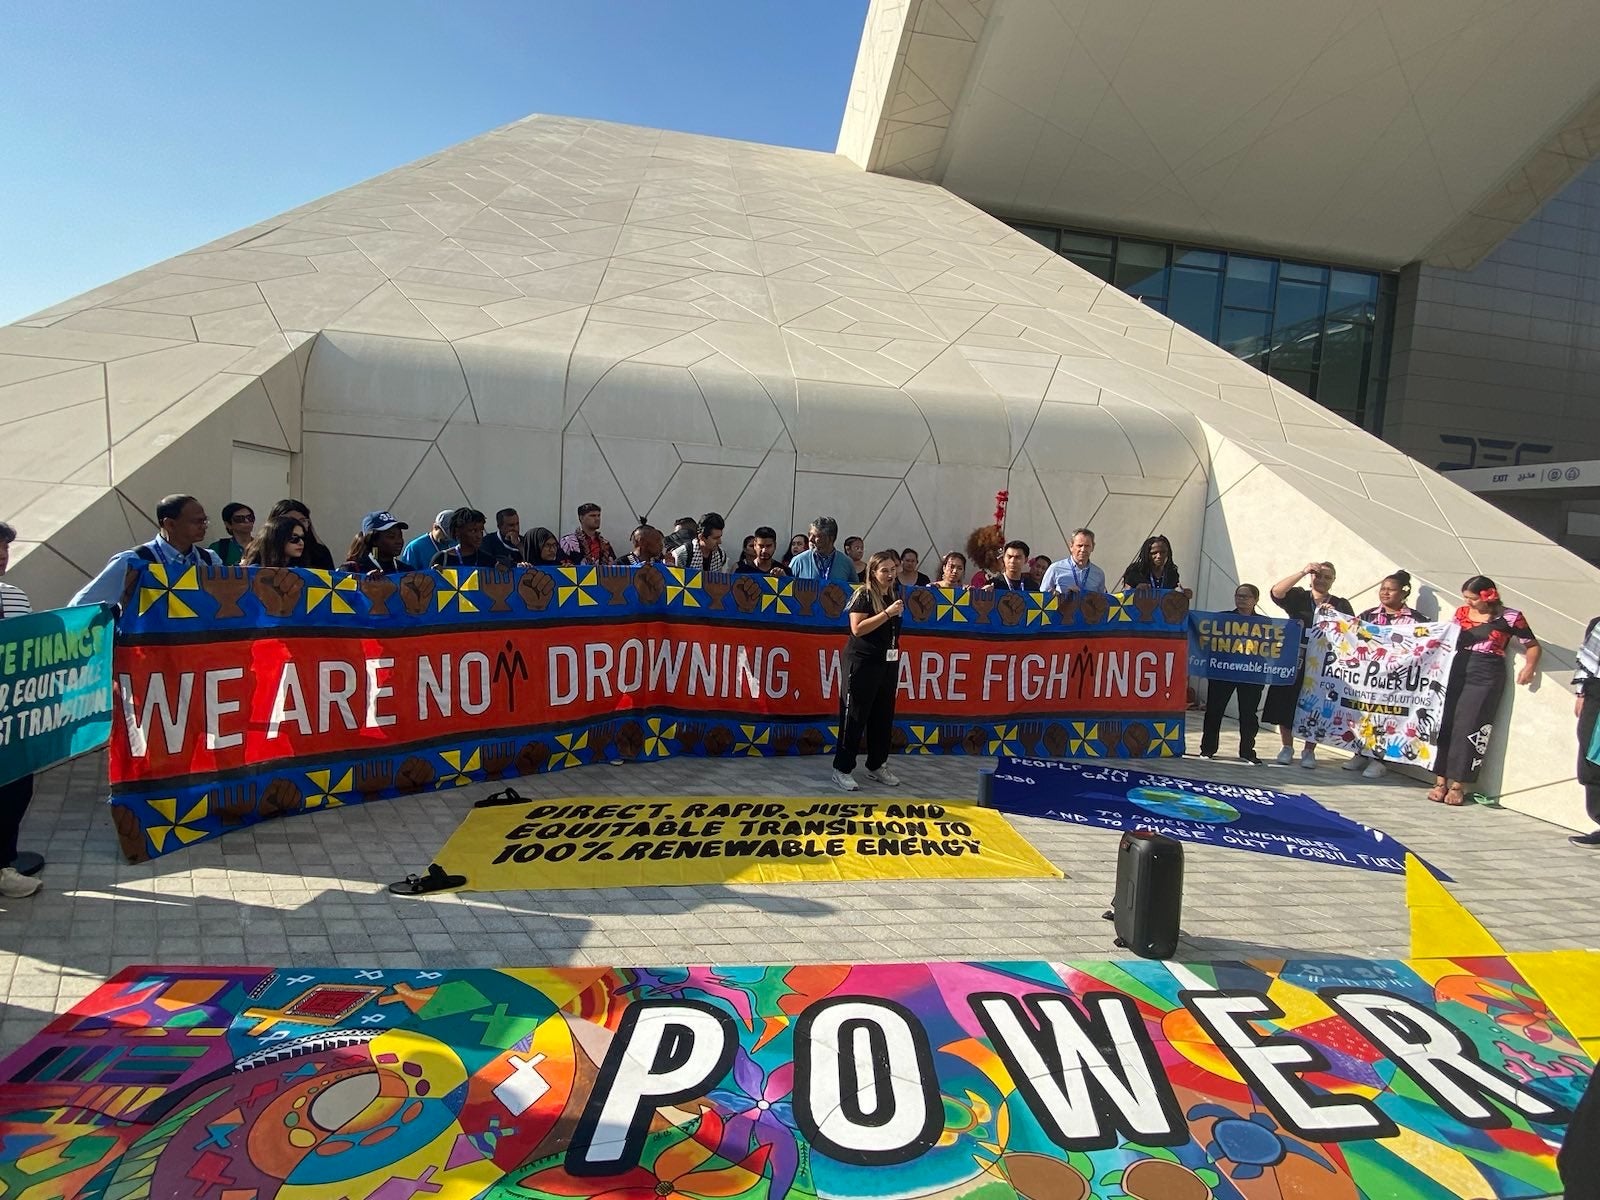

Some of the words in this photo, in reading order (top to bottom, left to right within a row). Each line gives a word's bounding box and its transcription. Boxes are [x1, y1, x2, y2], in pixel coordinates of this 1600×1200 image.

[1492, 474, 1508, 482] EXIT
[1199, 620, 1285, 640] CLIMATE
[22, 626, 104, 671] FINANCE
[1199, 636, 1284, 659] FINANCE
[1189, 655, 1207, 667] for
[1209, 657, 1262, 673] Renewable
[1263, 662, 1295, 679] Energy!
[1406, 665, 1430, 692] UP
[120, 667, 243, 757] WE
[266, 658, 397, 739] ARE
[896, 651, 970, 700] ARE
[1343, 686, 1377, 701] CLIMATE
[1382, 693, 1432, 706] SOLUTIONS
[1351, 701, 1402, 714] TUVALU
[795, 803, 879, 817] JUST
[885, 804, 946, 819] AND
[505, 820, 726, 840] EQUITABLE
[739, 819, 928, 837] TRANSITION
[933, 820, 972, 837] TO
[1045, 809, 1089, 822] AND
[1097, 817, 1123, 827] TO
[1134, 823, 1214, 840] PHASE
[1222, 835, 1270, 849] OUT
[1286, 844, 1357, 864] FOSSIL
[1095, 809, 1123, 818] TO
[1131, 813, 1190, 828] POWER
[1194, 822, 1216, 832] UP
[1223, 826, 1340, 852] RENEWABLES
[491, 841, 615, 865] 100%
[618, 838, 846, 861] RENEWABLE
[857, 837, 981, 857] ENERGY
[571, 990, 1560, 1172] POWER
